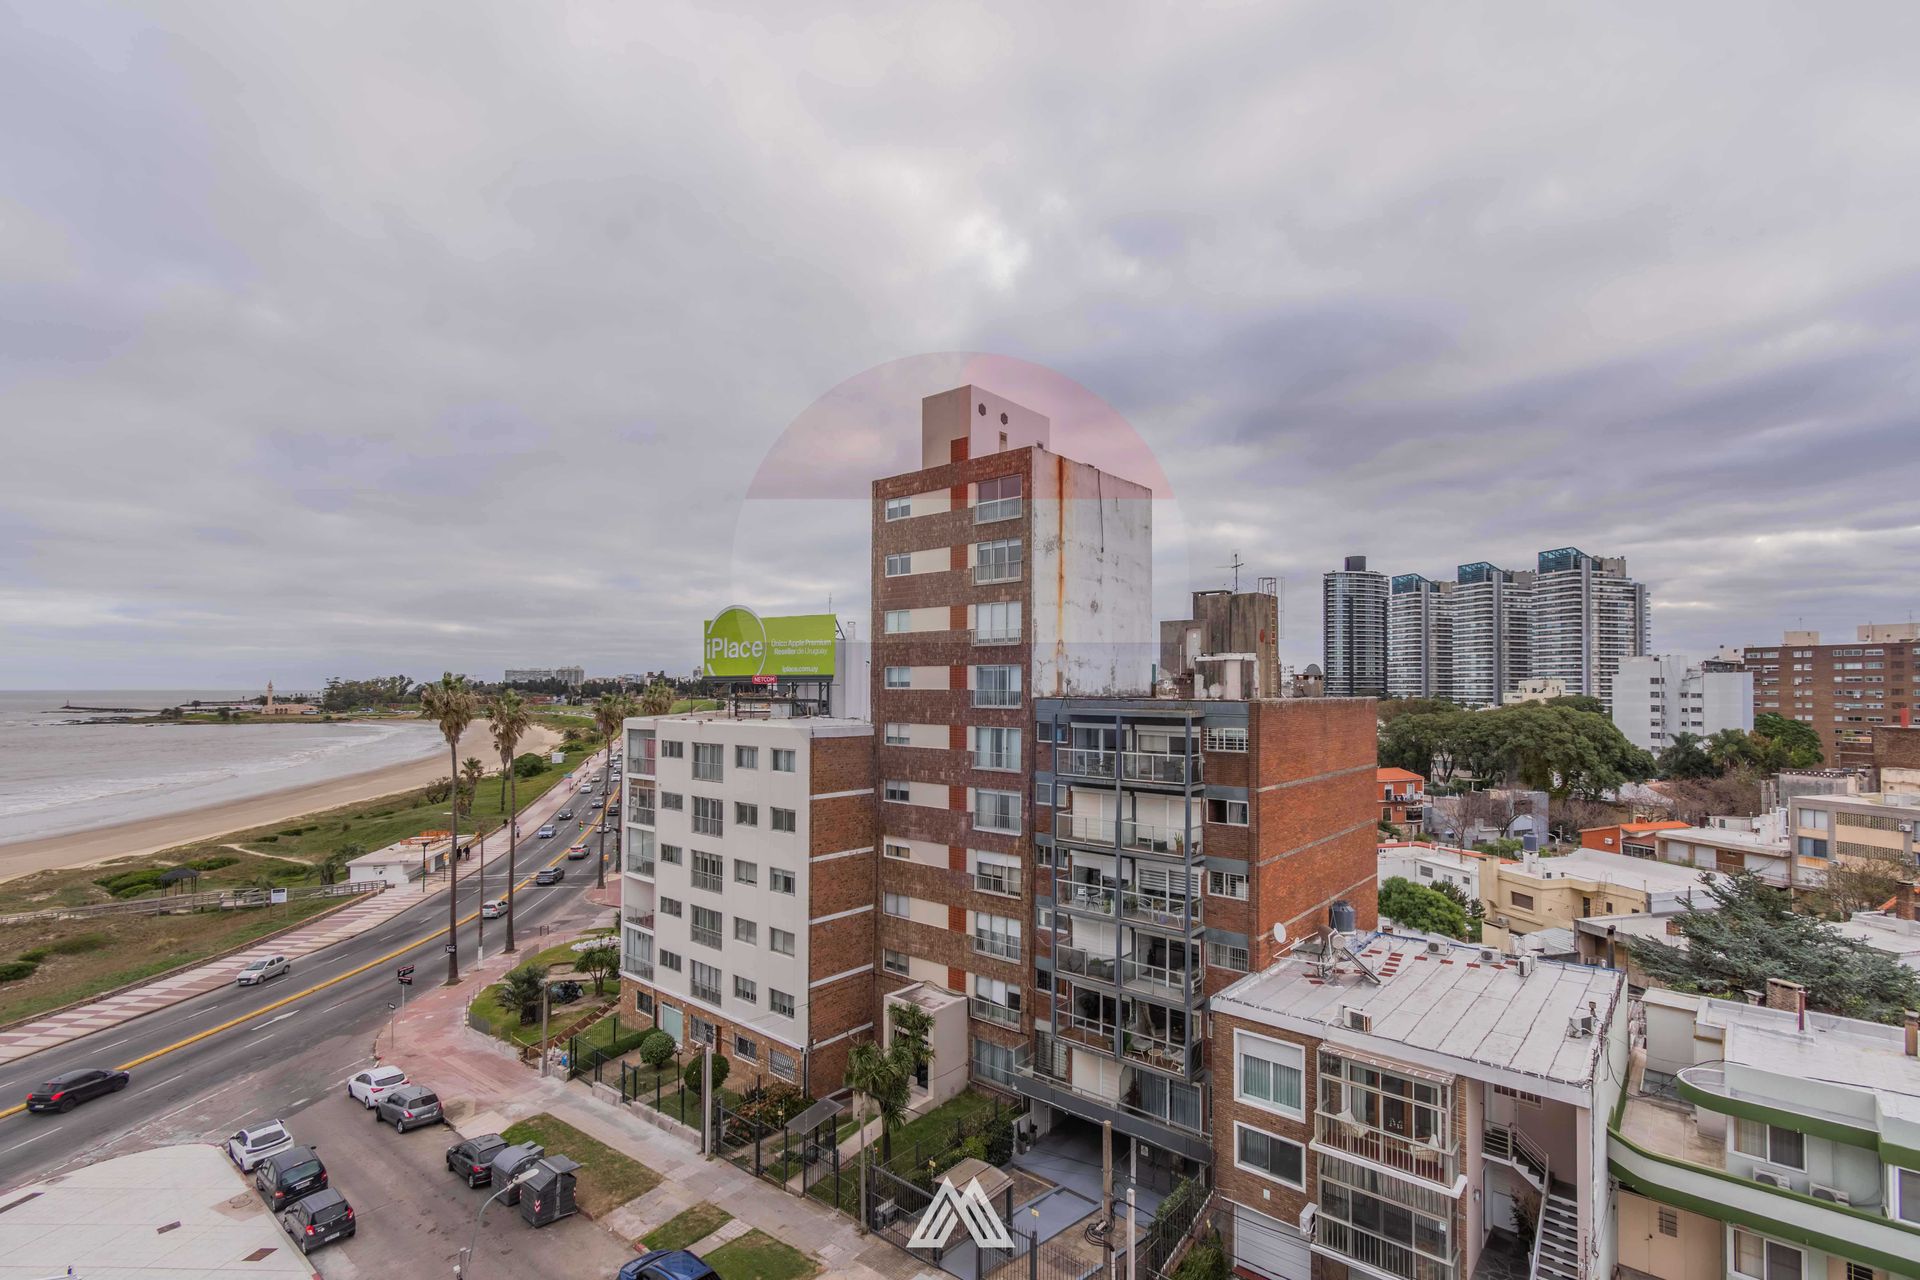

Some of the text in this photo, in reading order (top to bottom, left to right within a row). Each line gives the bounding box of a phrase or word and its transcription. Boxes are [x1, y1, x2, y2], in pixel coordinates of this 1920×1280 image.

[706, 637, 763, 659] iPlace
[788, 639, 804, 648] Apple
[805, 639, 832, 647] Premium
[805, 648, 828, 656] Uruguay
